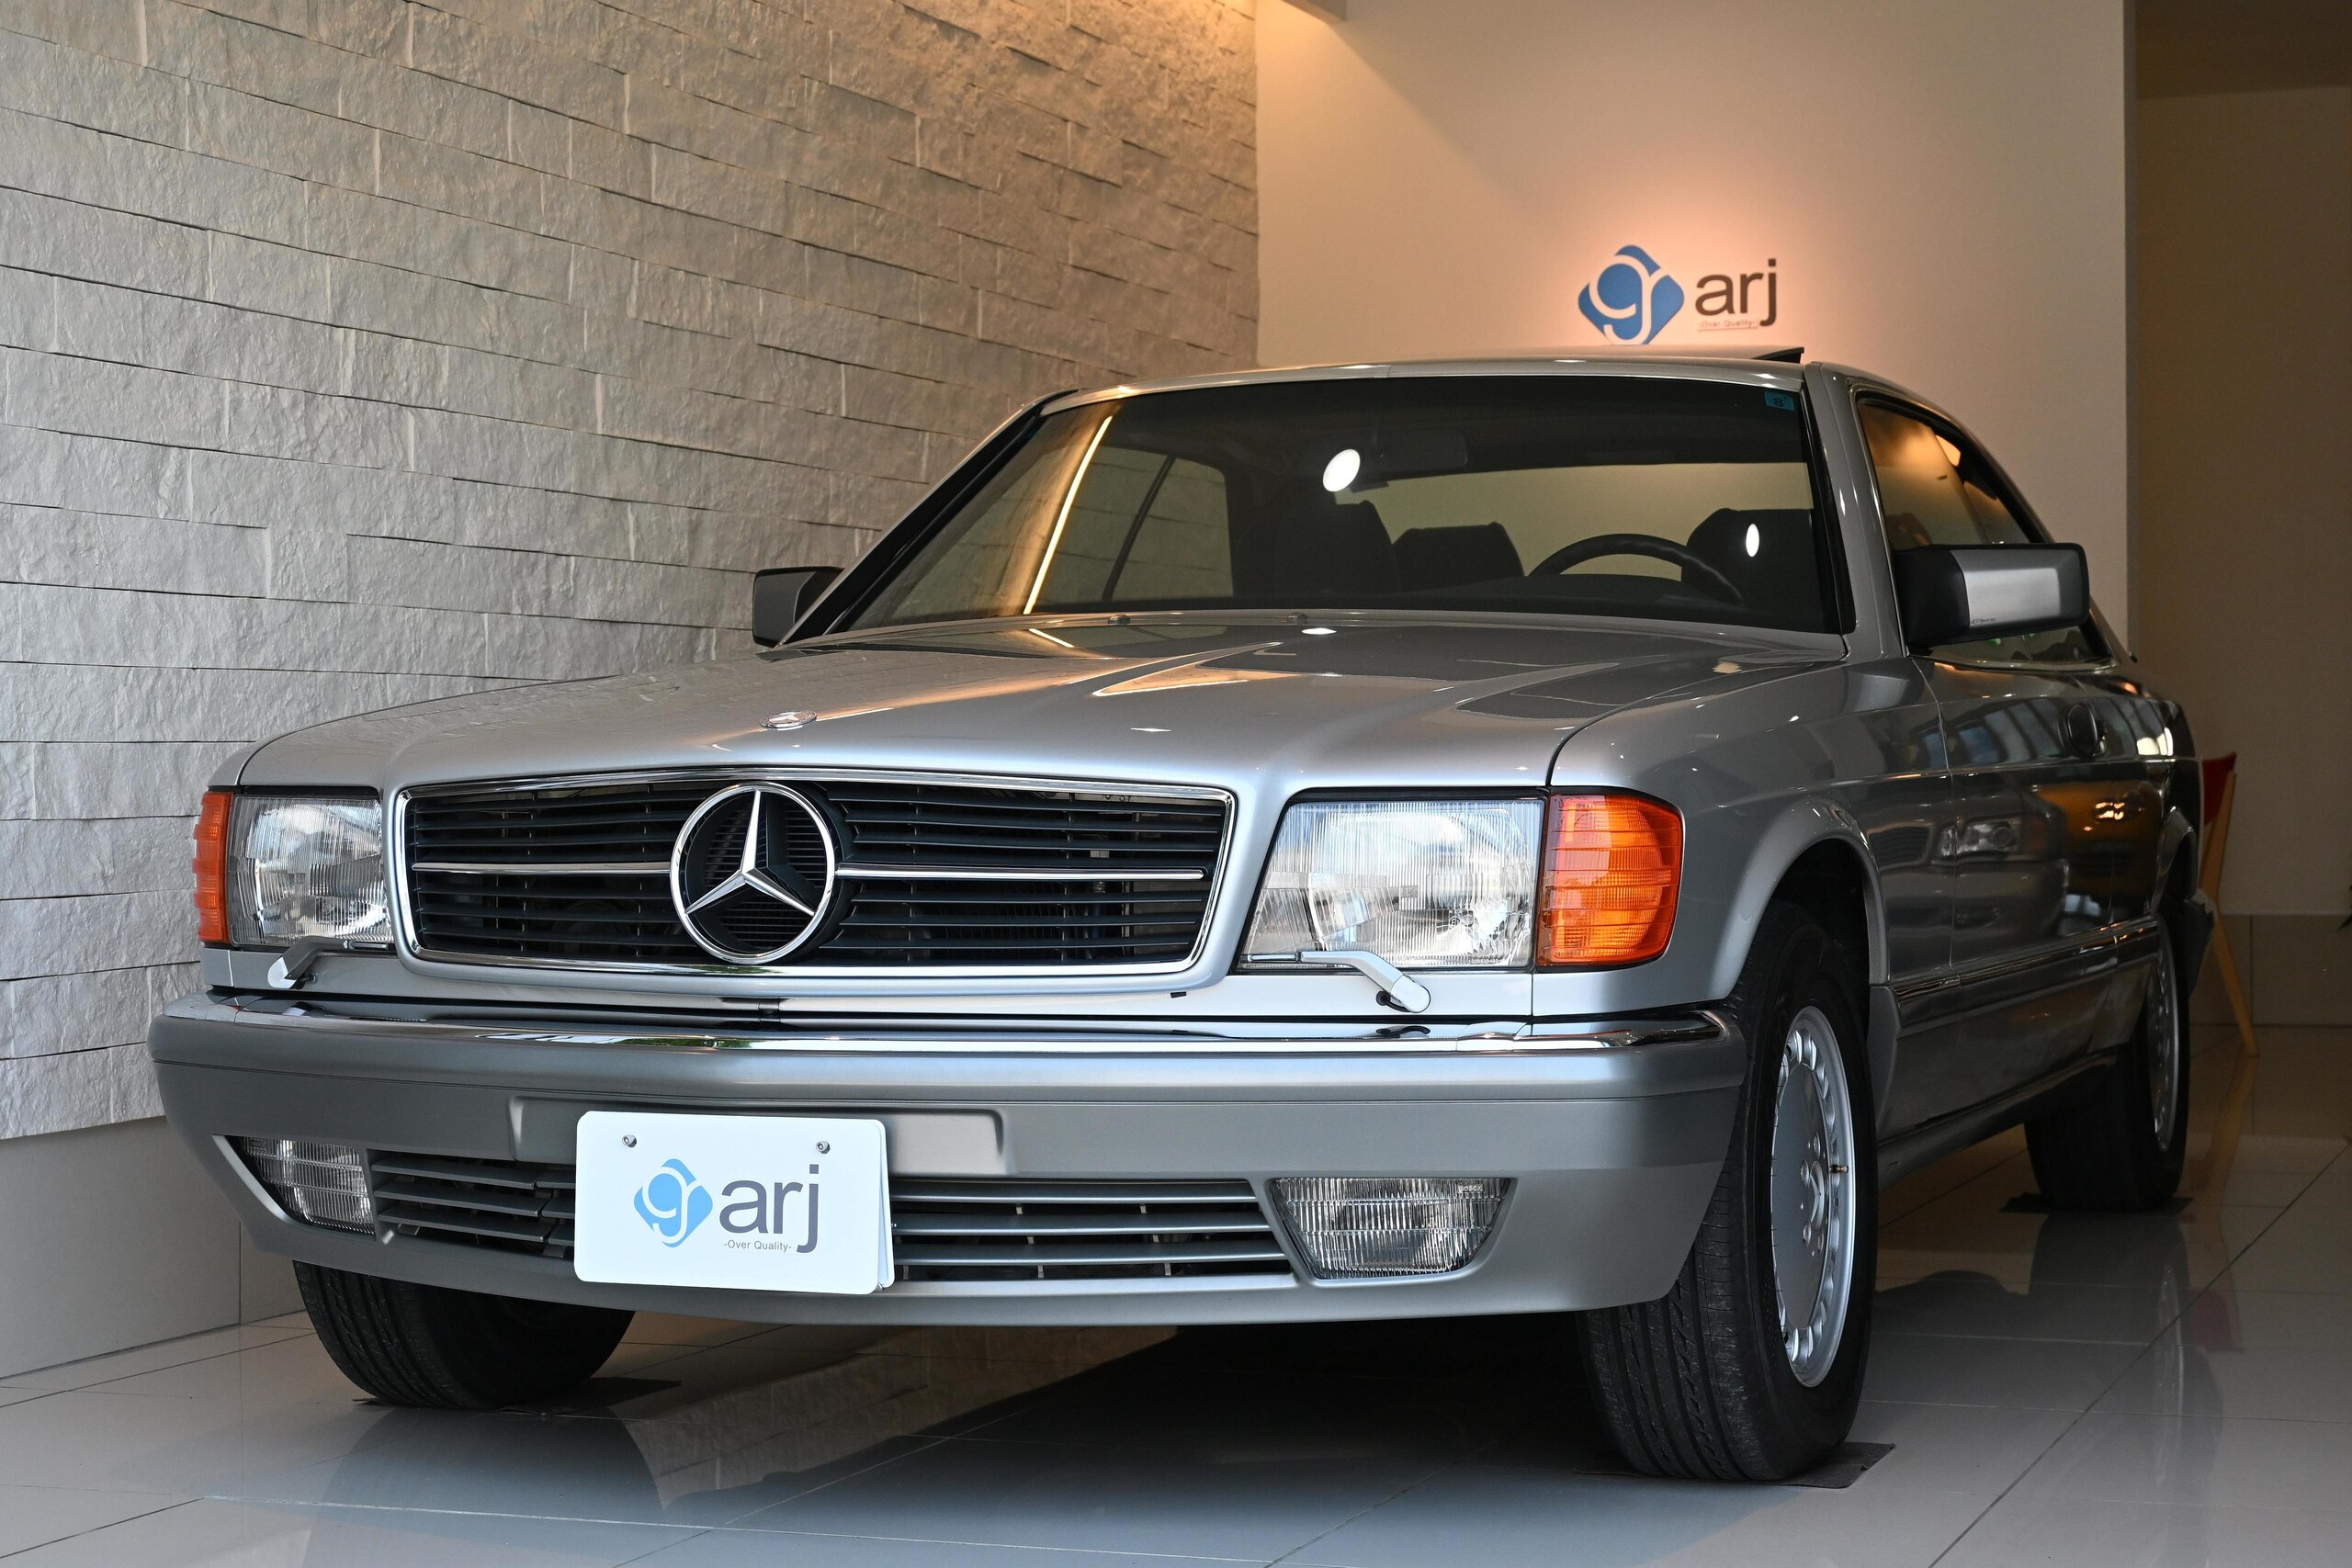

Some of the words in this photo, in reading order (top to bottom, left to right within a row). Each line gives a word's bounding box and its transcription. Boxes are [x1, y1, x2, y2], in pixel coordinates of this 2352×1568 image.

[1694, 257, 1777, 327] arj
[718, 1164, 820, 1254] arj
[724, 1239, 751, 1249] -Over
[753, 1240, 792, 1253] Quality-
